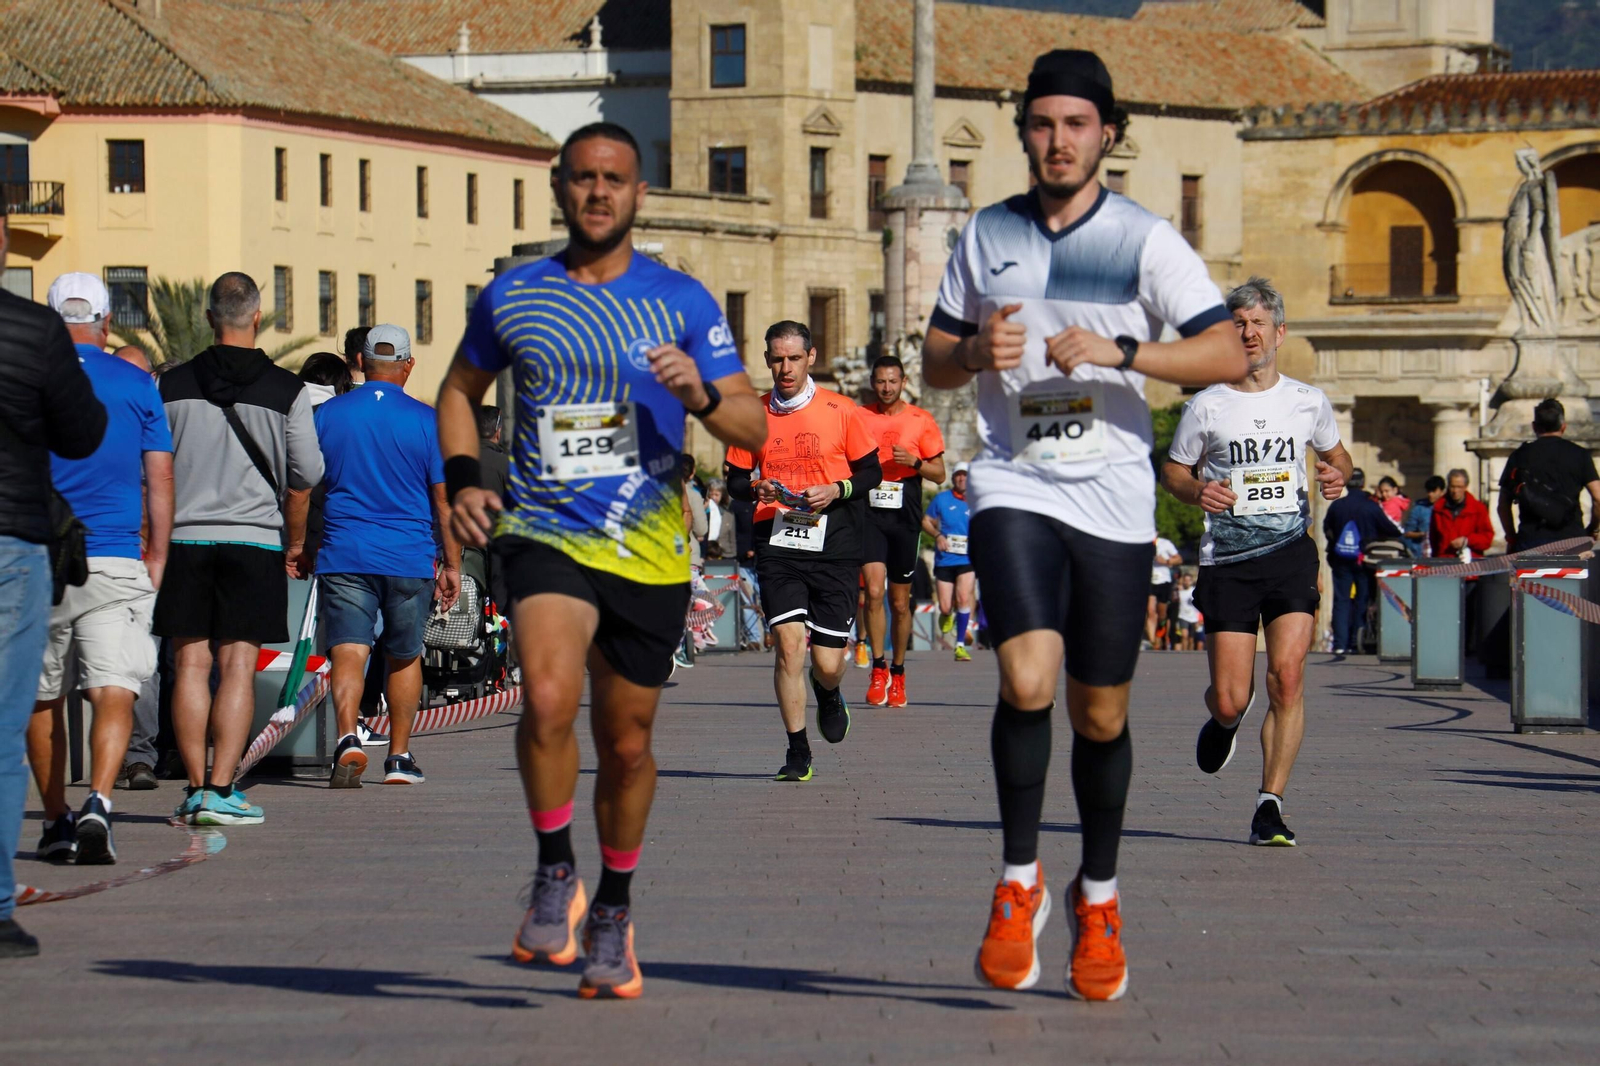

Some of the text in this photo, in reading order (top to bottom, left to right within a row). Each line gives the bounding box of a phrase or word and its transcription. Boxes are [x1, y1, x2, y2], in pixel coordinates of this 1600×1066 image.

[1026, 420, 1084, 441] 440
[560, 436, 613, 457] 129
[875, 492, 894, 500] 124
[1248, 486, 1284, 501] 283
[785, 526, 810, 540] 211
